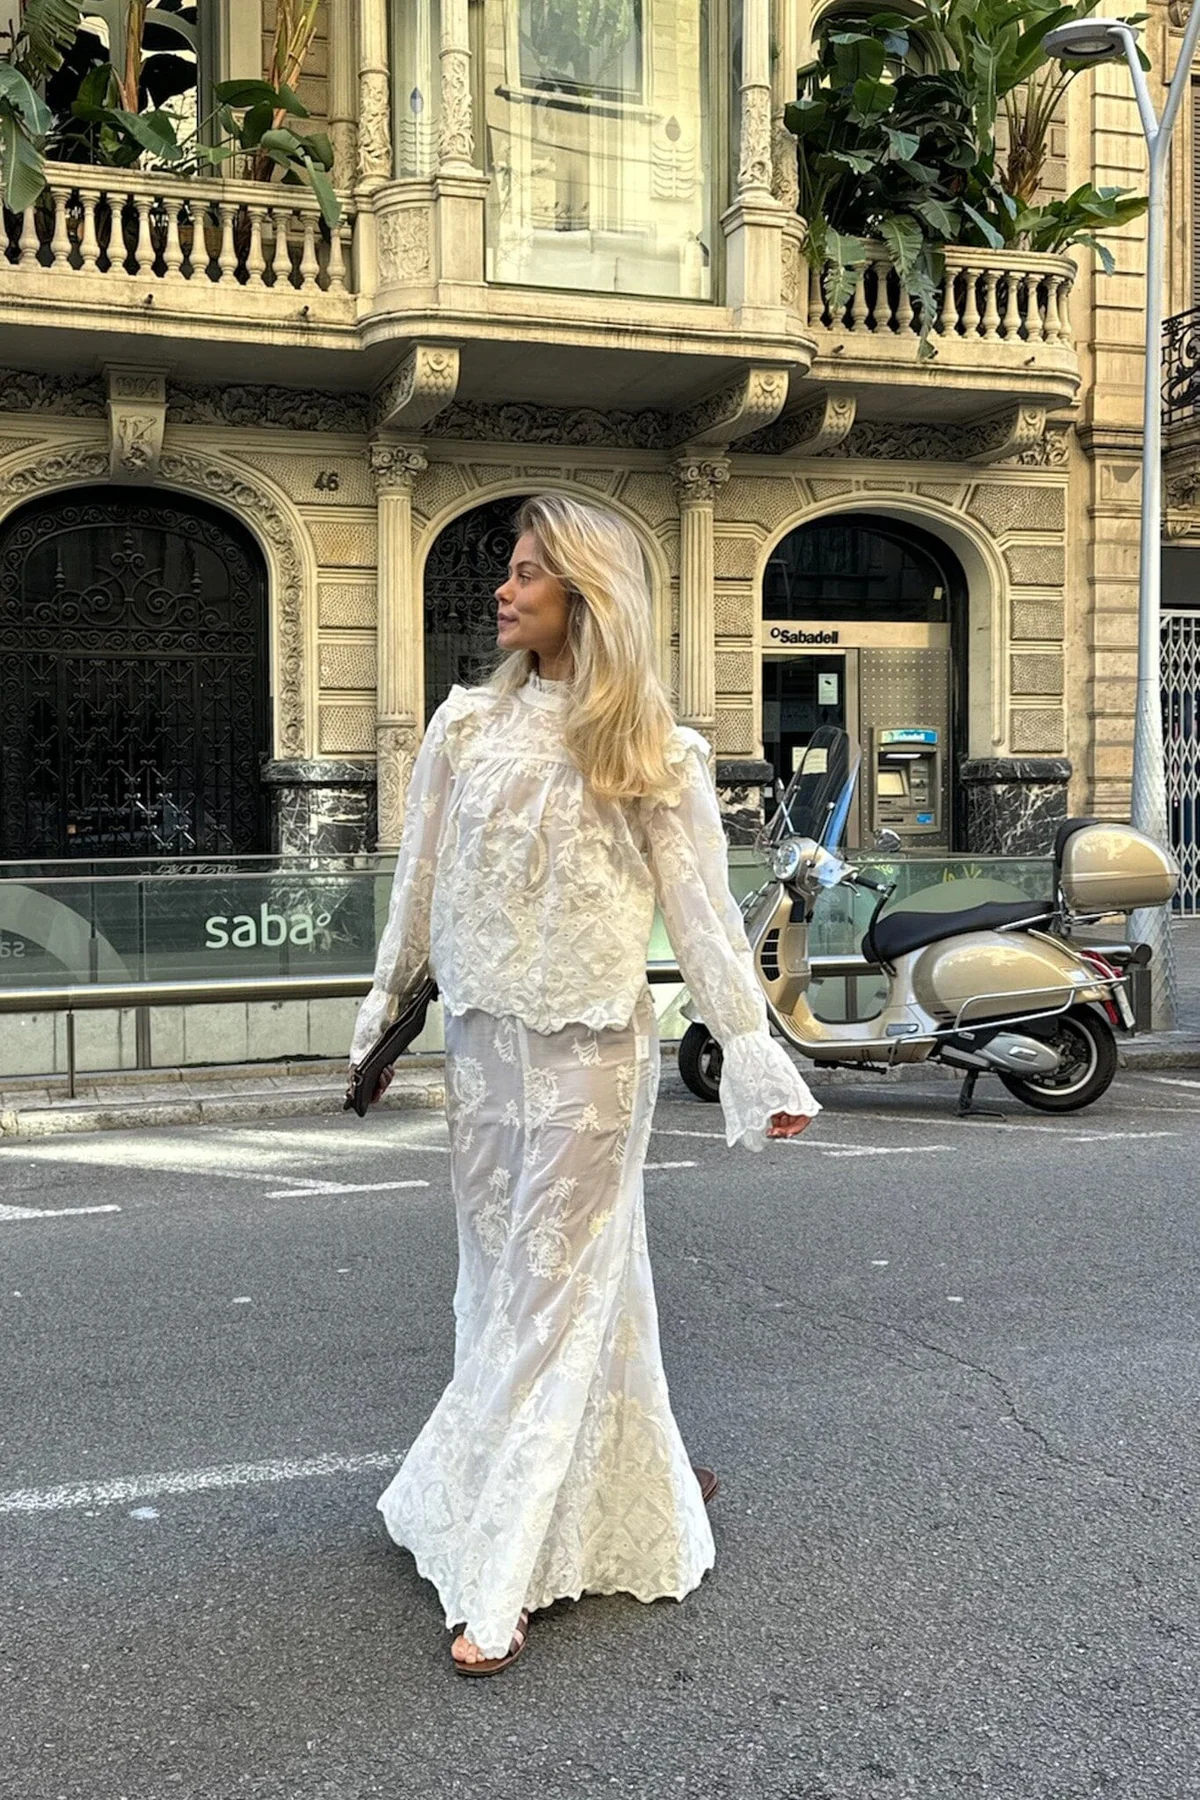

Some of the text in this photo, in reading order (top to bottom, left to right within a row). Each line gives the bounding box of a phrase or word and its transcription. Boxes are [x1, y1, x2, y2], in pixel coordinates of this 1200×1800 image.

[314, 471, 340, 491] 46
[780, 629, 839, 644] Sabadell
[205, 902, 314, 949] saba
